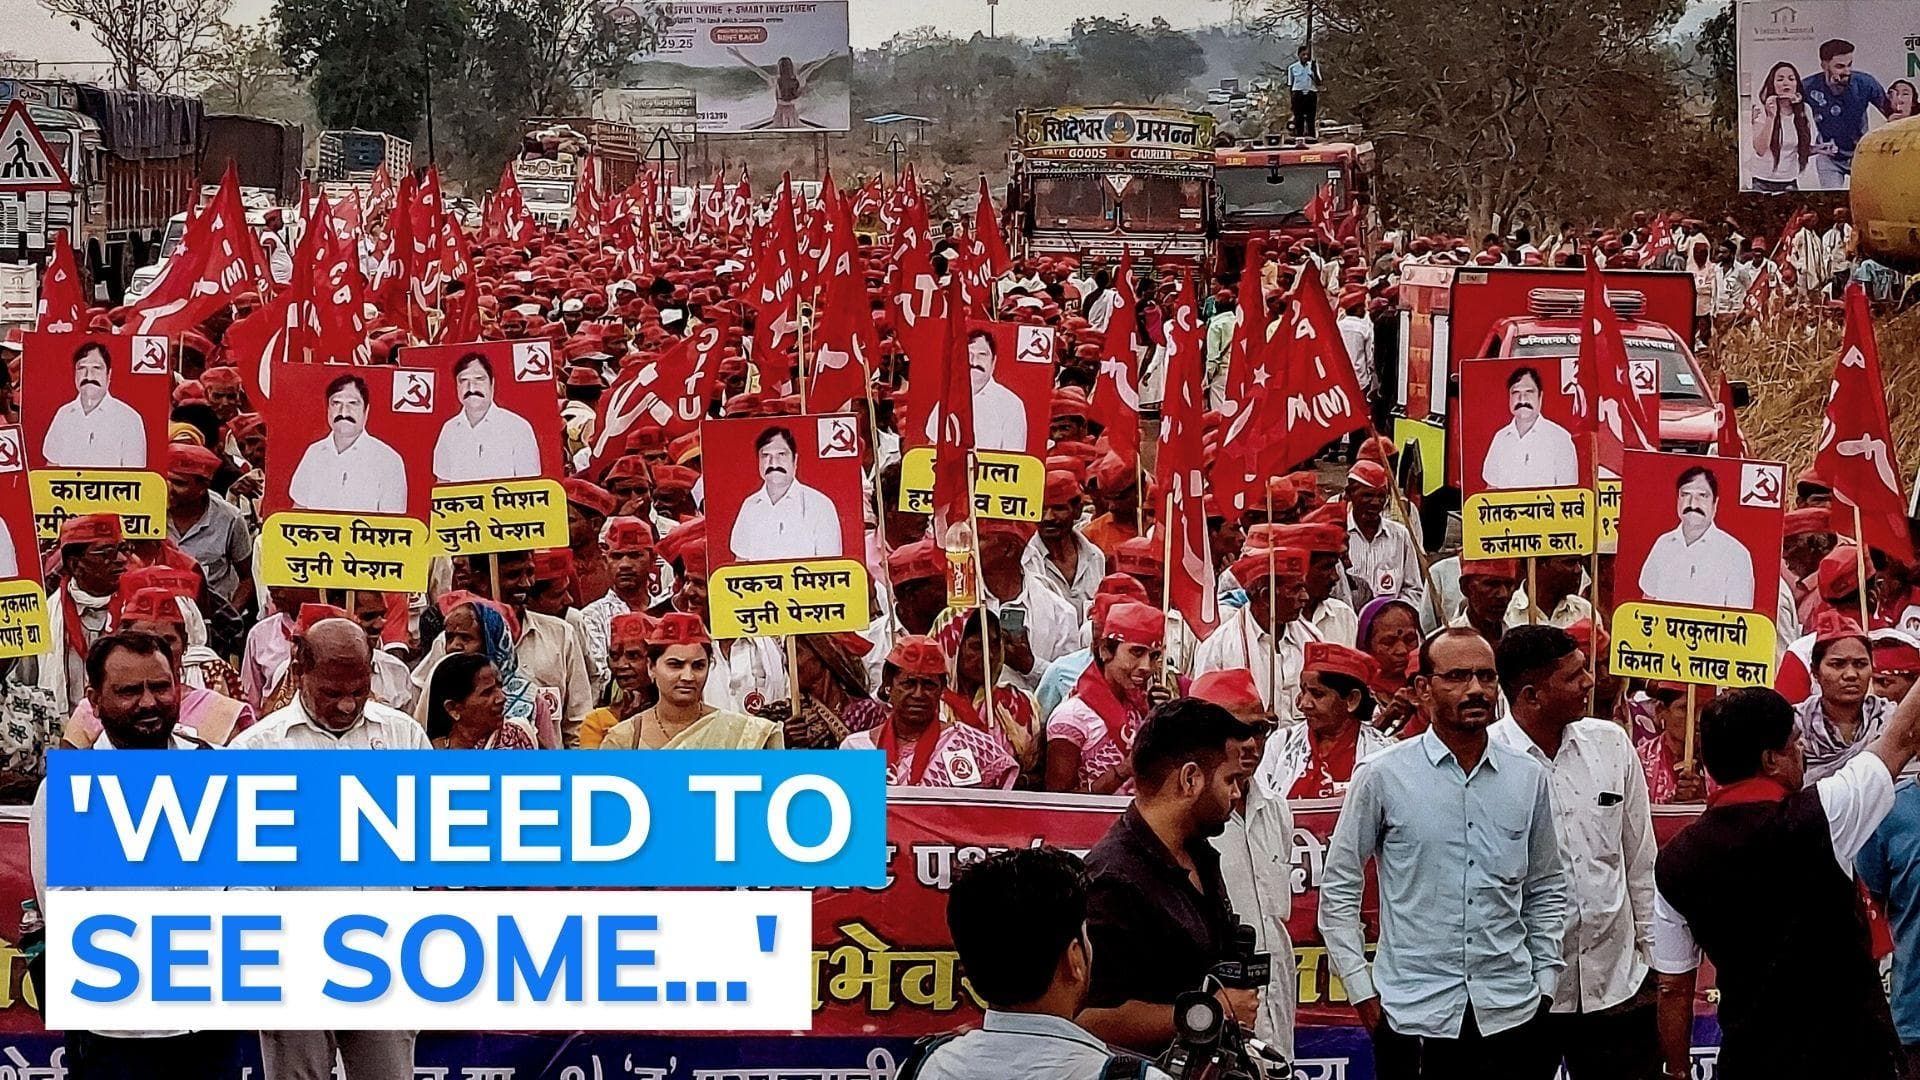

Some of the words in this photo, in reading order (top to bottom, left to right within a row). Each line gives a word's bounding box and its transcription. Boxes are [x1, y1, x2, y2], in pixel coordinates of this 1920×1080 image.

[1136, 119, 1200, 145] प्रसन्न
[1068, 148, 1107, 160] GOODS
[1130, 149, 1172, 160] CARRIER
[49, 471, 141, 502] कांद्याला
[432, 494, 484, 518] एकच
[492, 486, 549, 510] मिशन
[999, 495, 1036, 518] द्या.
[1561, 493, 1586, 519] सर्व
[280, 523, 342, 547] एकच
[350, 519, 412, 547] मिशन
[437, 521, 481, 551] जुनी
[487, 518, 545, 541] पेन्शन
[1480, 528, 1542, 554] कर्जमाफ
[1548, 533, 1584, 551] करा.
[285, 552, 333, 583] जुनी
[341, 552, 404, 580] पेन्शन
[725, 575, 784, 598] एकच
[791, 566, 851, 591] मिशन
[734, 601, 779, 633] जुनी
[787, 598, 846, 623] पेन्शन
[25, 625, 41, 644] द्या
[1665, 613, 1748, 651] घरकुलांची
[1689, 656, 1730, 680] लाख
[1735, 660, 1768, 685] करा
